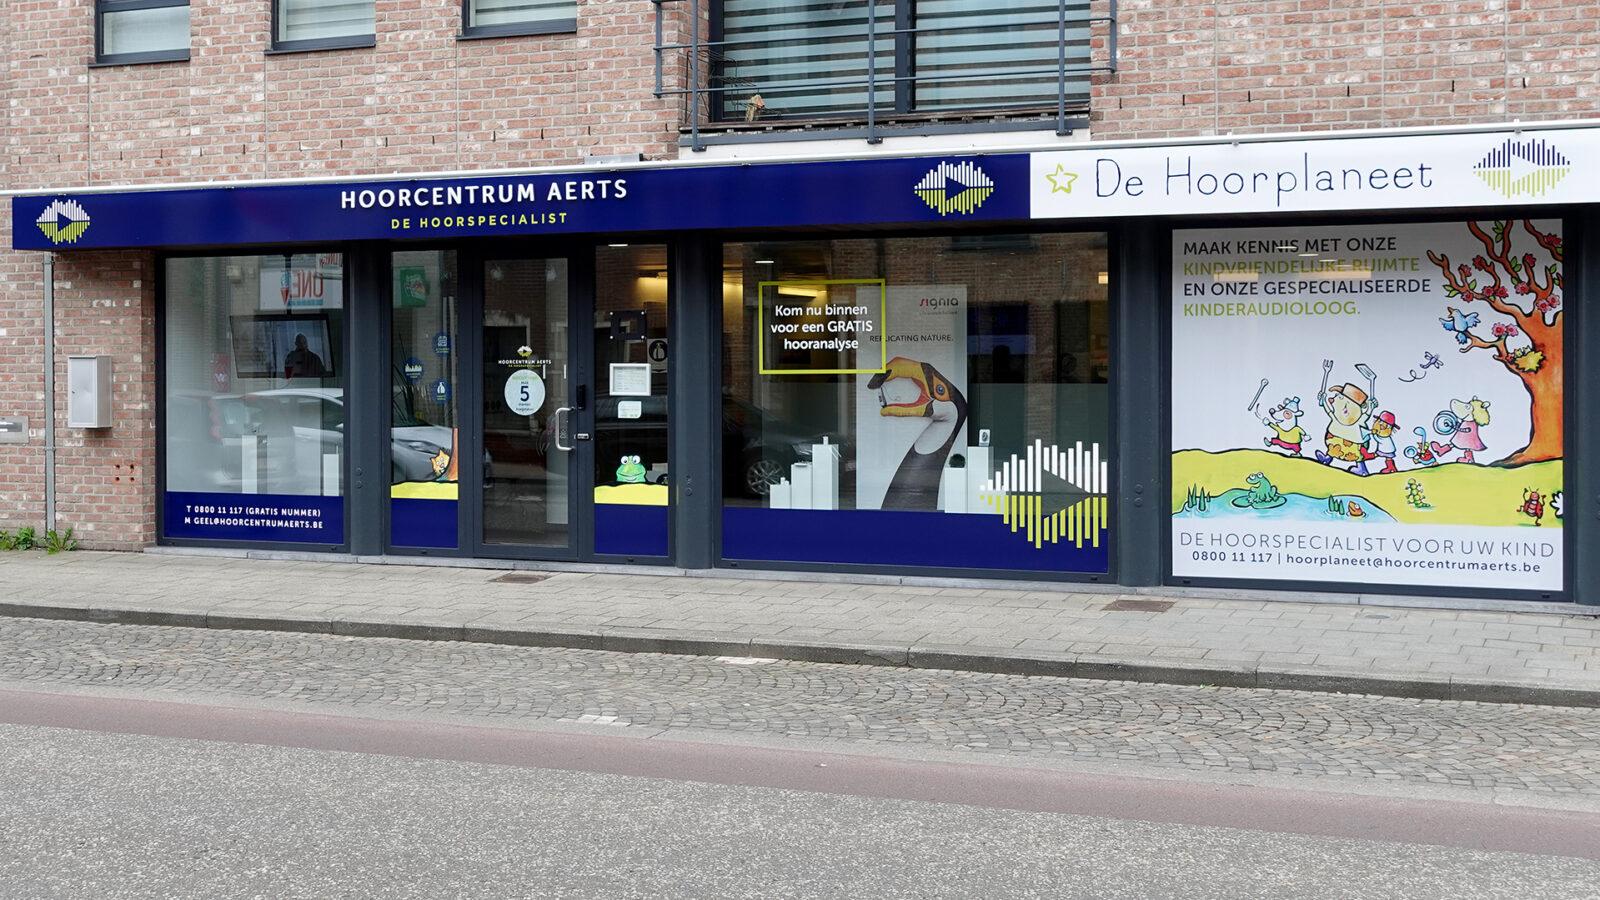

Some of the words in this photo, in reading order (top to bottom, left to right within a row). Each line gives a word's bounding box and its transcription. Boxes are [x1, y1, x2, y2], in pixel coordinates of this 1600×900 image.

[1096, 158, 1144, 198] De
[1166, 152, 1432, 206] Hoorplaneet
[341, 183, 535, 208] HOORCENTRUM
[547, 179, 627, 201] AERTS
[391, 218, 410, 229] DE
[420, 212, 567, 228] HOORSPECIALIST
[1183, 241, 1231, 255] MAAK
[1237, 239, 1299, 254] KENNIS
[1305, 238, 1341, 252] MET
[1347, 237, 1396, 252] ONZE
[1183, 258, 1349, 275] KINDVRIENDELIJKE
[1353, 257, 1420, 272] RUIMTE
[1183, 282, 1205, 296] EN
[1210, 281, 1258, 296] ONZE
[1264, 278, 1431, 295] GESPECIALISEERDE
[775, 305, 803, 316] Kom
[806, 306, 822, 316] nu
[825, 304, 868, 315] binnen
[919, 297, 959, 310] signia
[1183, 301, 1361, 317] KINDERAUDIOLOOG.
[770, 323, 798, 333] voor
[801, 323, 824, 333] een
[827, 320, 873, 332] GRATIS
[783, 338, 859, 352] hooranalyse
[520, 385, 530, 402] 5
[186, 505, 192, 513] T
[194, 505, 215, 513] 0800
[217, 506, 227, 514] 11
[229, 506, 243, 515] 117
[245, 507, 278, 516] (GRATIS
[281, 508, 321, 517] NUMMER)
[184, 516, 191, 524] M
[193, 517, 323, 529] GEEL@HOORCENTRUMAERTS.BE
[1180, 532, 1204, 546] DE
[1210, 533, 1386, 551] HOORSPECIALIST
[1392, 538, 1454, 554] VOOR
[1461, 540, 1494, 555] UW
[1501, 541, 1554, 557] KIND
[1192, 550, 1226, 562] 0800
[1231, 552, 1245, 562] 11
[1250, 552, 1273, 563] 117
[1286, 554, 1541, 573] hoorplaneet@hoorcentrumaerts.be
